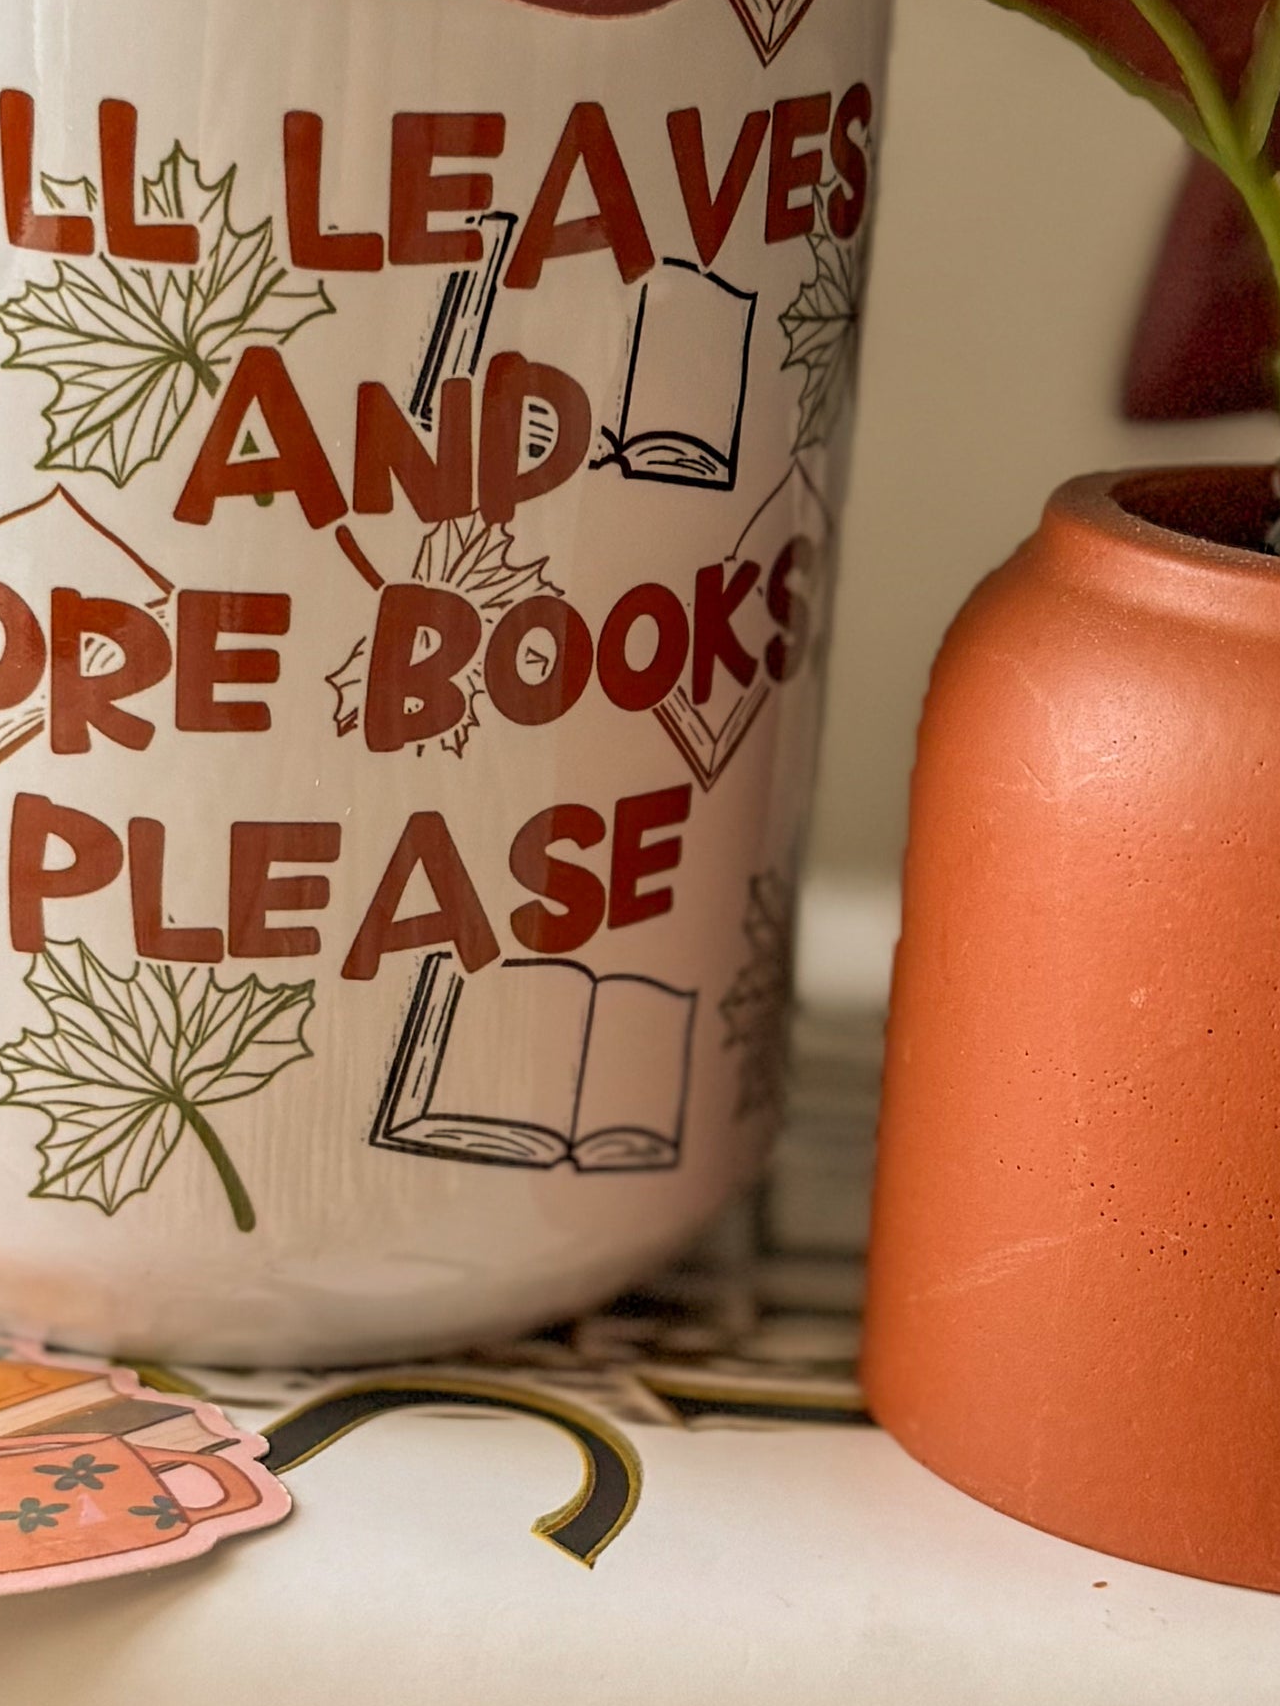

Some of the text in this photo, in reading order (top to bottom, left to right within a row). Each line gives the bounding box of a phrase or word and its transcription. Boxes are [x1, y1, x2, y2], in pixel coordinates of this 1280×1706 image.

[282, 82, 873, 290] LEAVES
[172, 346, 592, 529] AND
[362, 535, 812, 755] BOOKS
[7, 783, 693, 981] PLEASE
